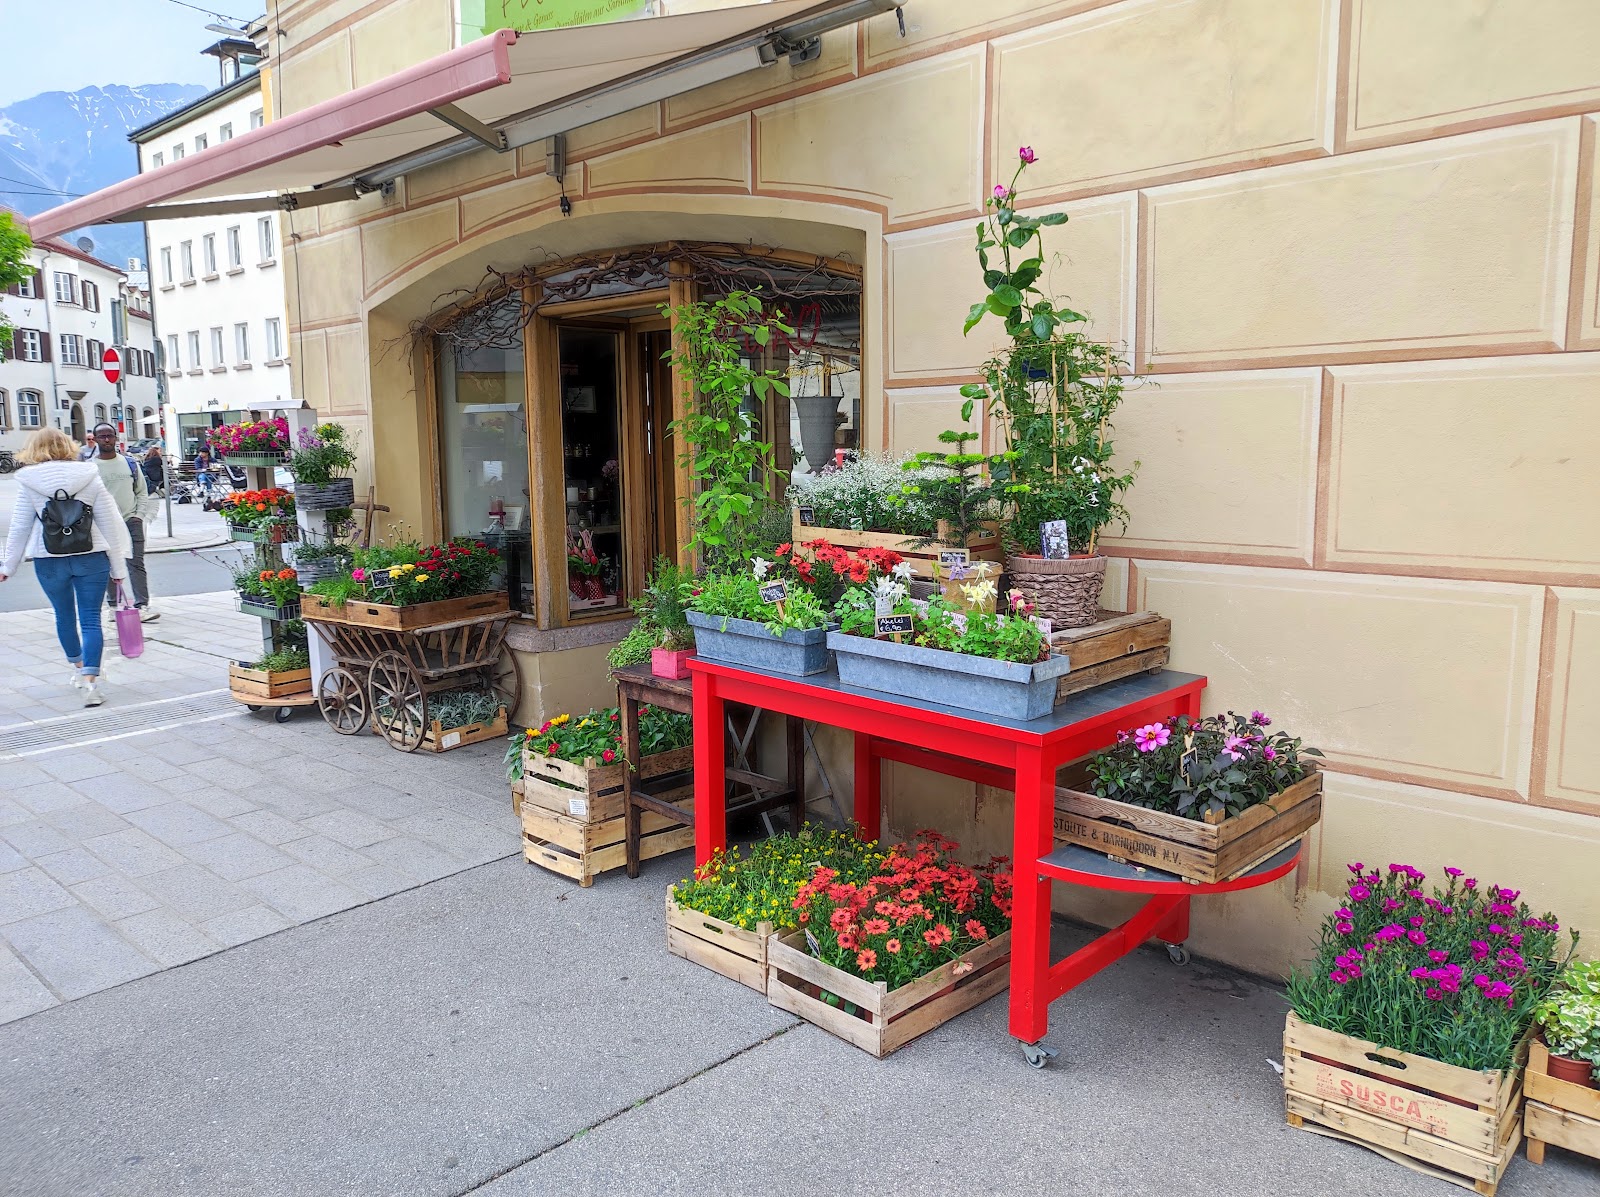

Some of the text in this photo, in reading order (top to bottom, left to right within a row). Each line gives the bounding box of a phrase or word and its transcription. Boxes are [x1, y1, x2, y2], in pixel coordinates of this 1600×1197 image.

[1053, 818, 1088, 837] STOUTE
[1091, 828, 1099, 840] &
[1340, 1079, 1422, 1118] SUSCA
